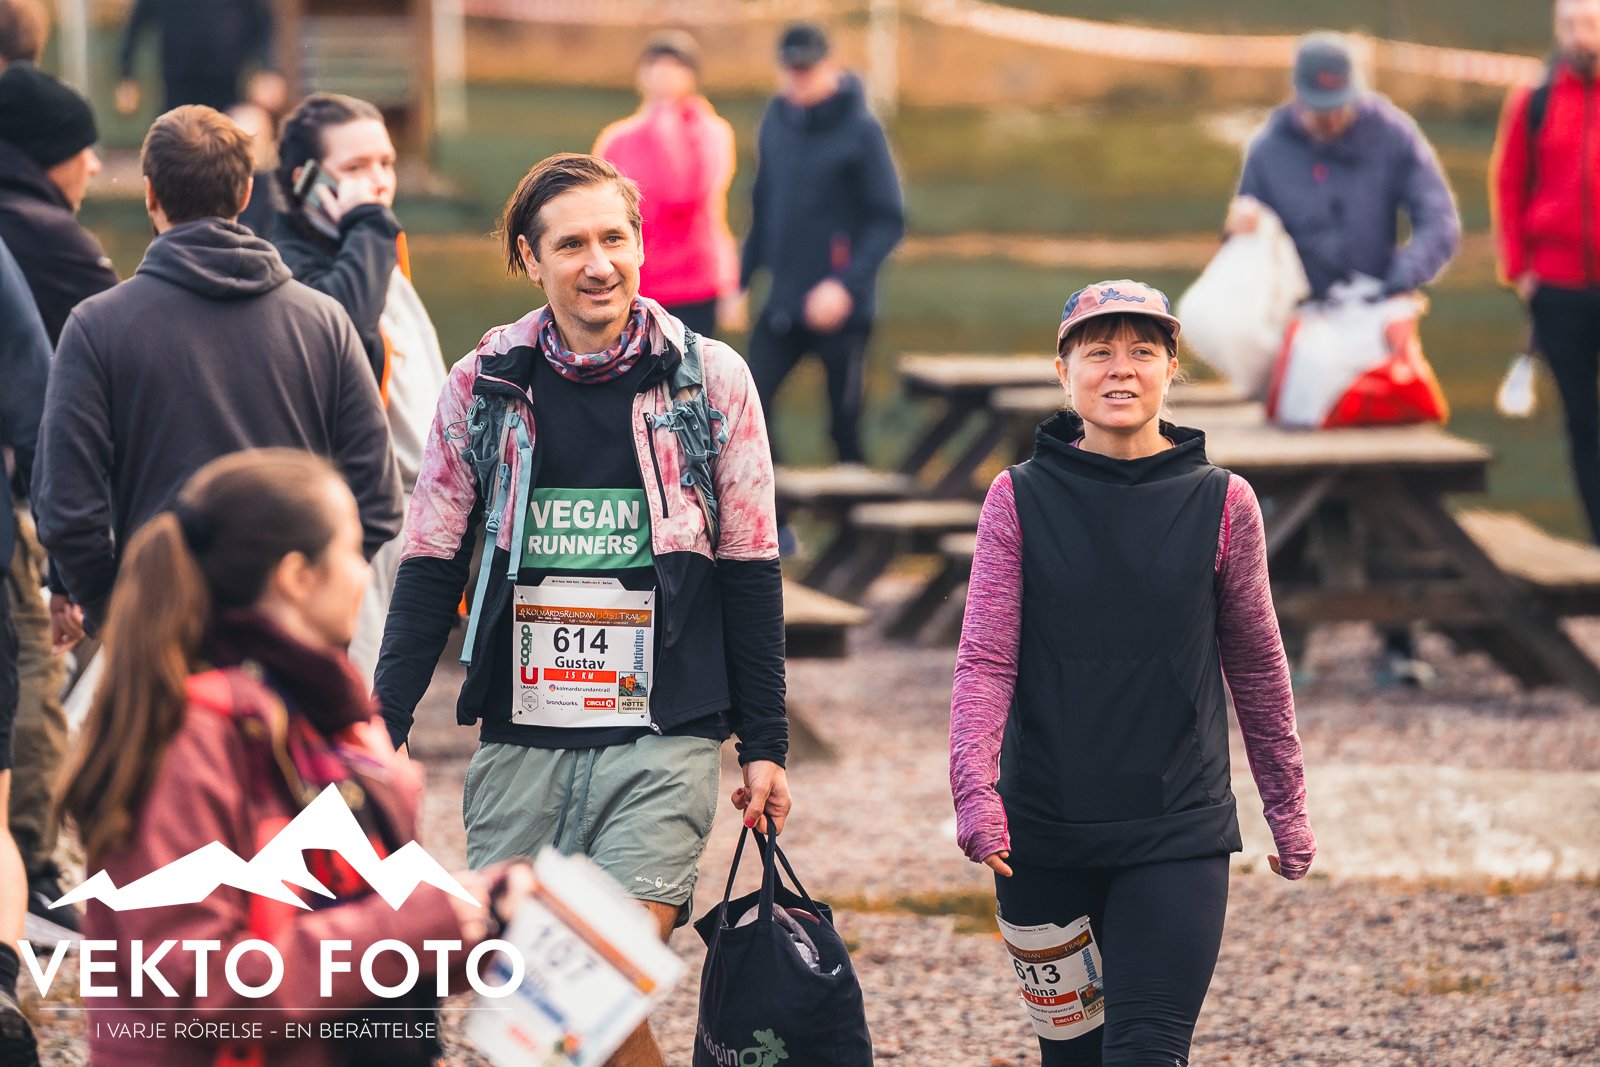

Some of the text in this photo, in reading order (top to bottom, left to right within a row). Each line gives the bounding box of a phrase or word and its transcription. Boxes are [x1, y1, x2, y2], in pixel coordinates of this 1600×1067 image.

[530, 499, 640, 529] VEGAN
[528, 534, 638, 556] RUNNERS
[520, 624, 533, 667] coop
[553, 626, 609, 654] 614
[633, 629, 645, 671] Aktivitus
[555, 656, 605, 670] Gustav
[1013, 958, 1061, 985] 613
[1024, 983, 1057, 996] Anna
